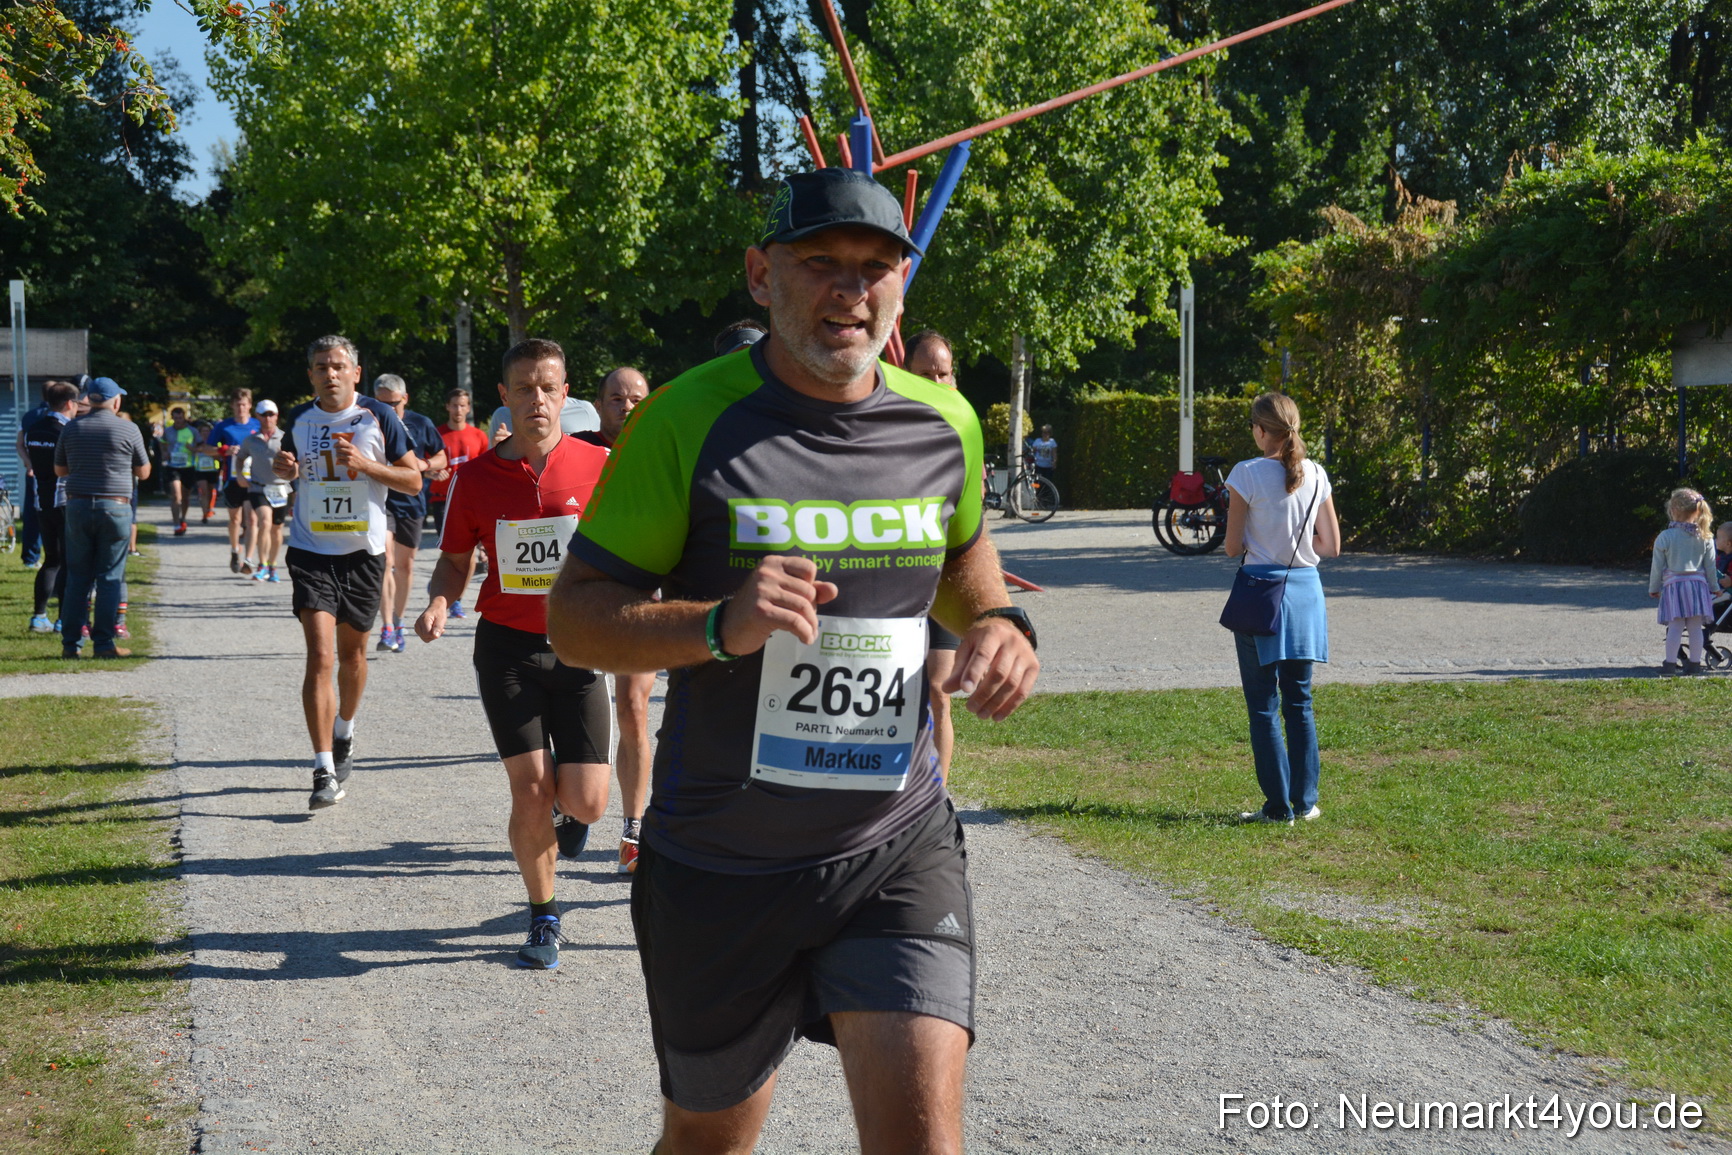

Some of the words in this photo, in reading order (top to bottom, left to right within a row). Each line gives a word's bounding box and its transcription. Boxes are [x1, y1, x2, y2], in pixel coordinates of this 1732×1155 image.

[322, 497, 352, 514] 171
[518, 525, 556, 536] BOCK
[732, 499, 945, 549] BOCK
[515, 539, 561, 564] 204
[839, 555, 891, 570] smart
[820, 632, 893, 653] BOCK
[786, 662, 906, 718] 2634
[795, 722, 832, 735] PARTL
[835, 725, 884, 737] Neumarkt
[804, 746, 882, 771] Markus
